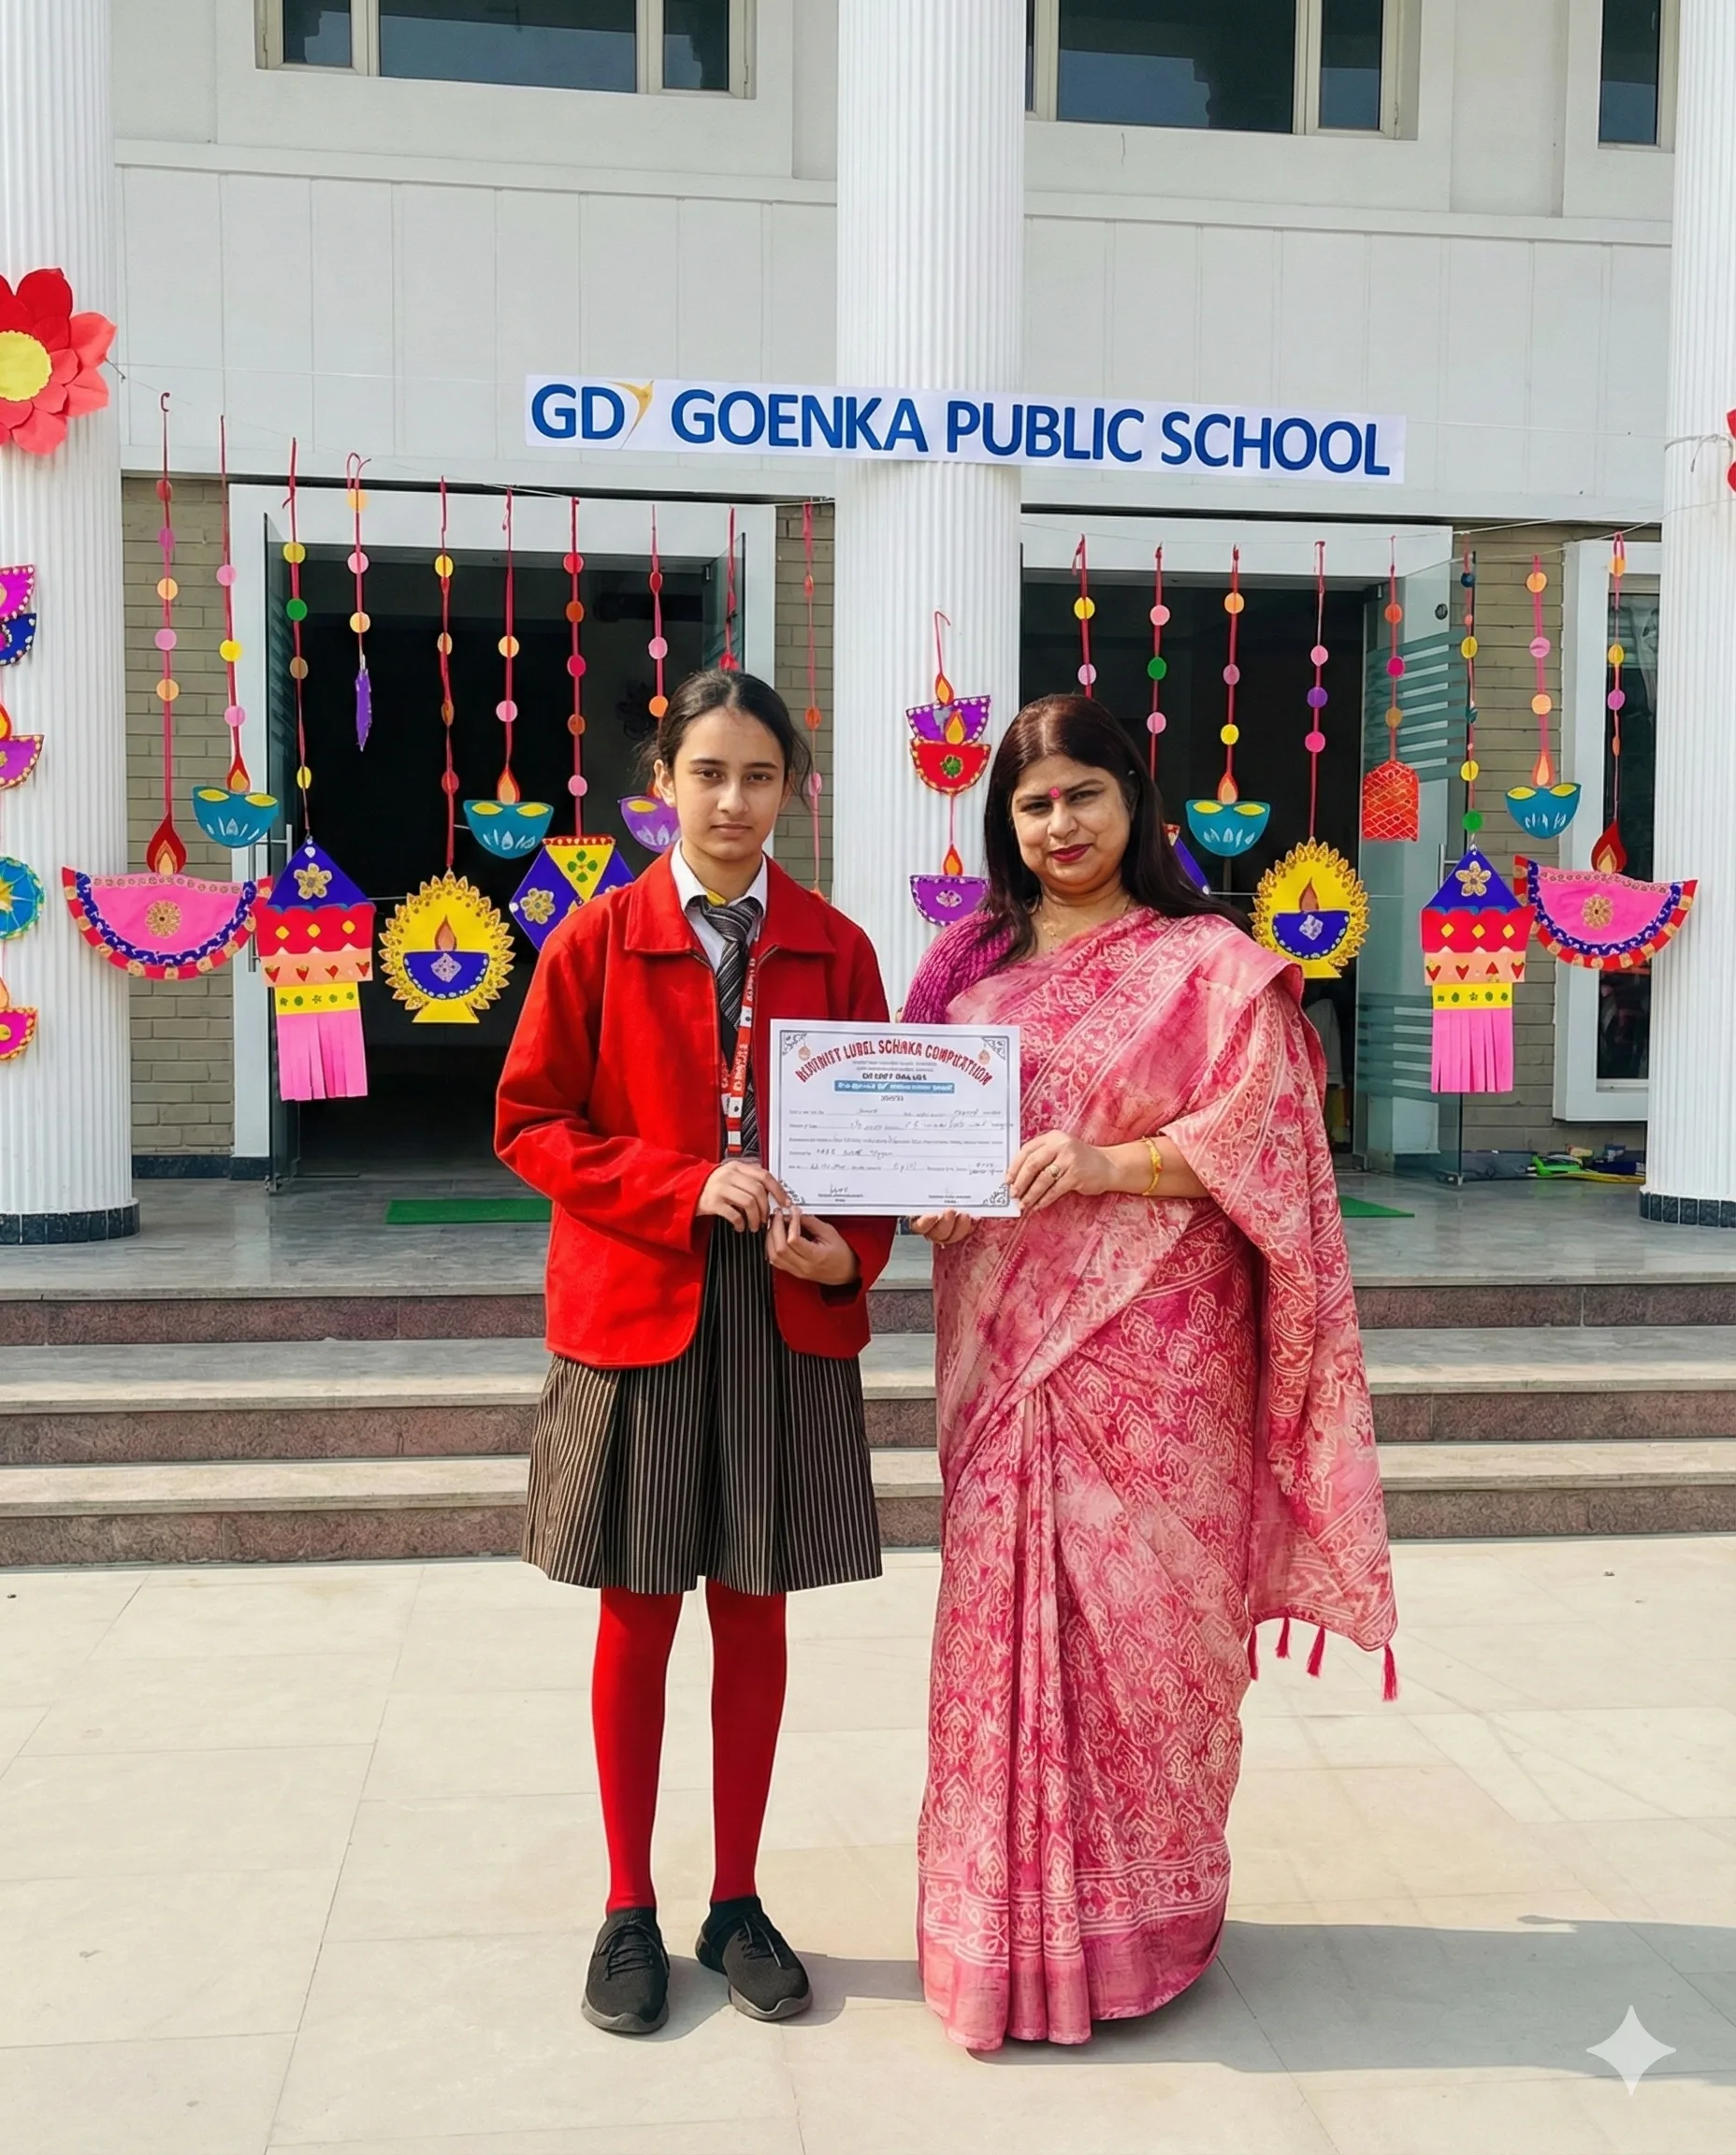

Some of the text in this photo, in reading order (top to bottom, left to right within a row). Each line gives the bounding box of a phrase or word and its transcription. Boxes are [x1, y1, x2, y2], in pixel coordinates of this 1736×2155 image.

[531, 383, 1389, 475] GD GOENKA PUBLIC SCHOOL
